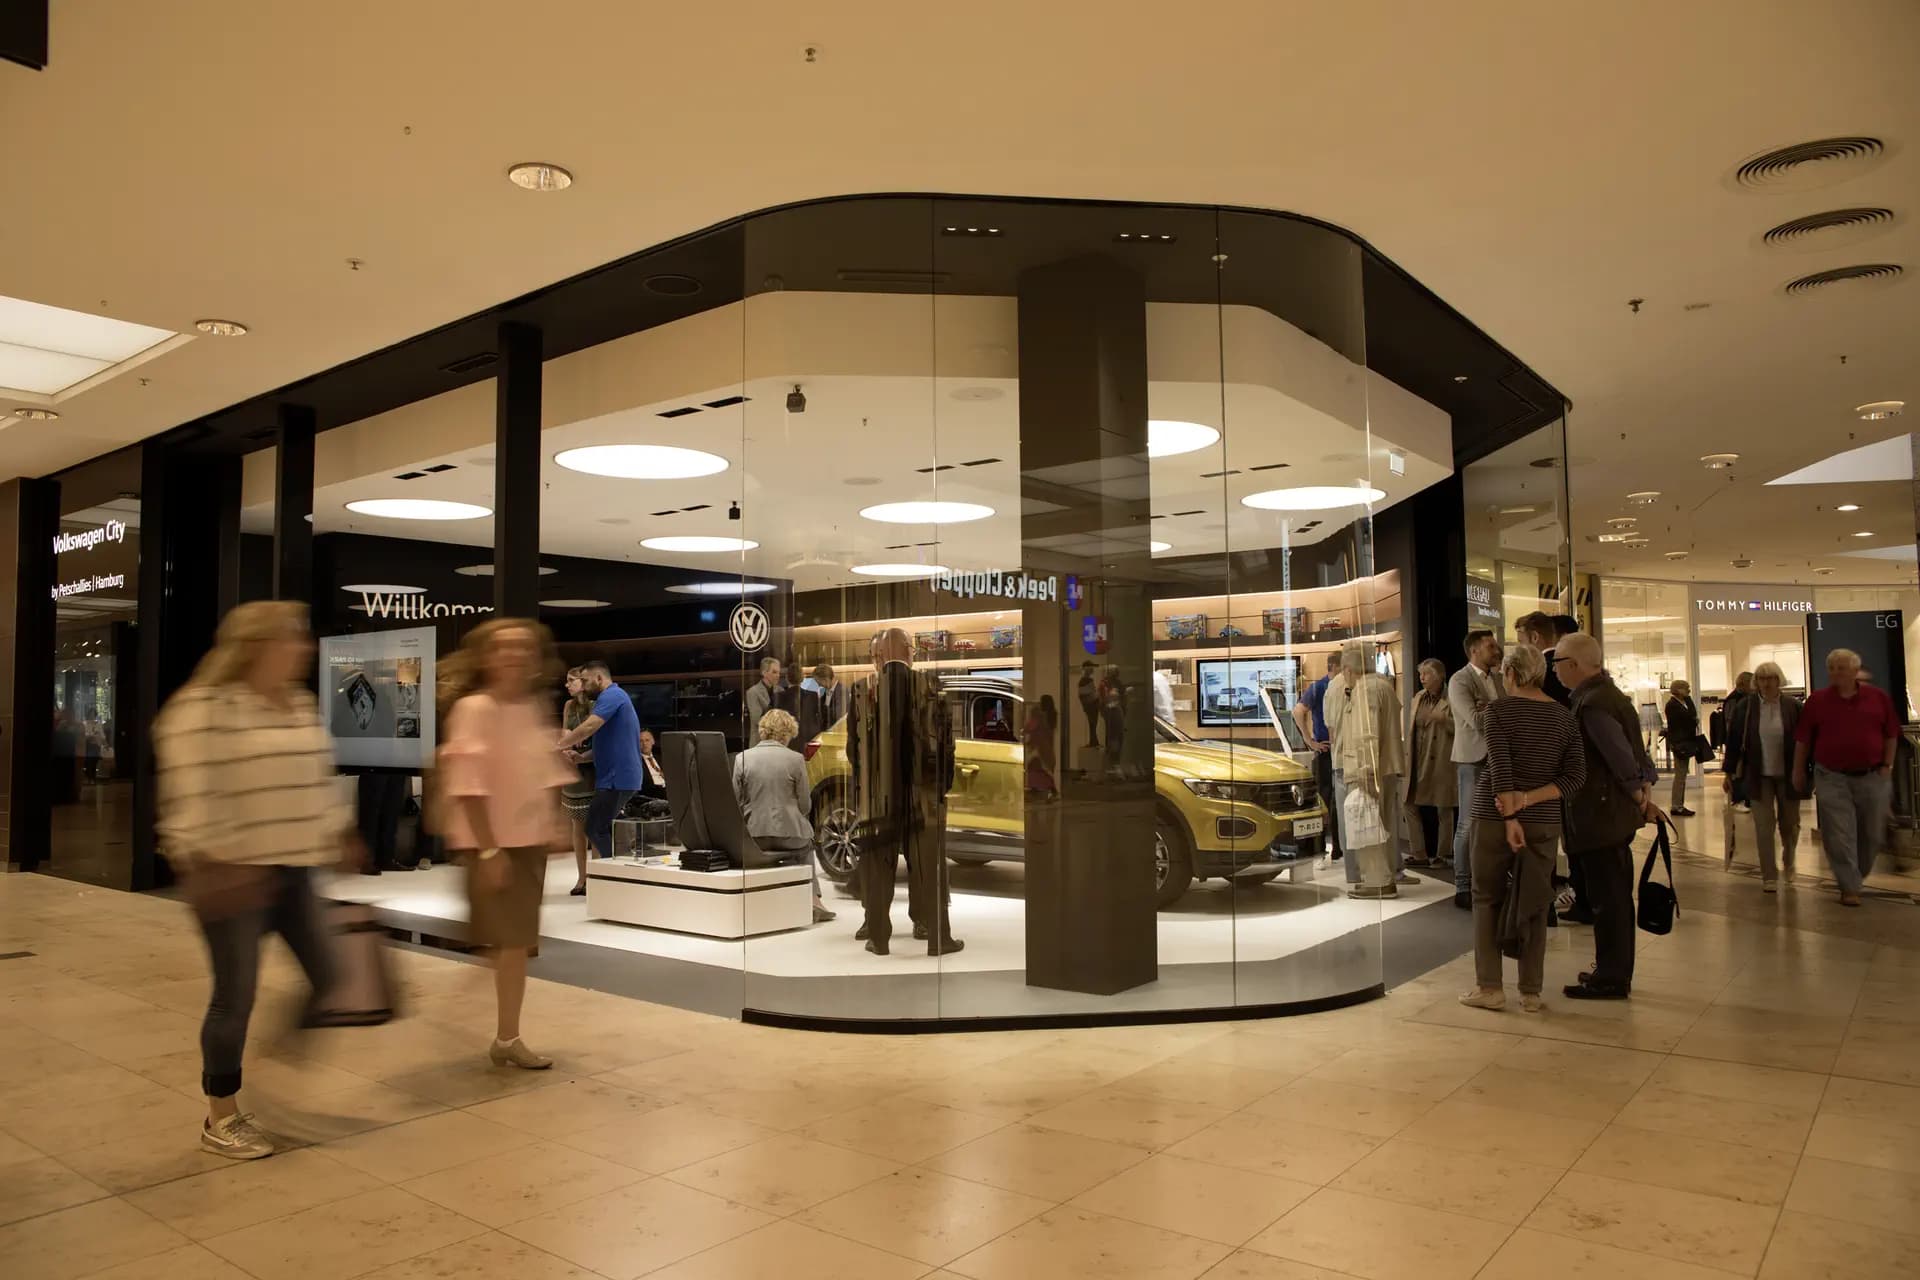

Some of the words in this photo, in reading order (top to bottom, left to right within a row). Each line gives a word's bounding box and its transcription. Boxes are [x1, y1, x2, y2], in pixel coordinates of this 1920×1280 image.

[53, 527, 104, 554] Volkswagen
[106, 519, 126, 543] City
[51, 585, 59, 600] by
[95, 573, 124, 589] Hamburg
[1696, 600, 1746, 611] TOMMY
[1764, 601, 1813, 612] HILFIGER
[1875, 614, 1898, 629] EG
